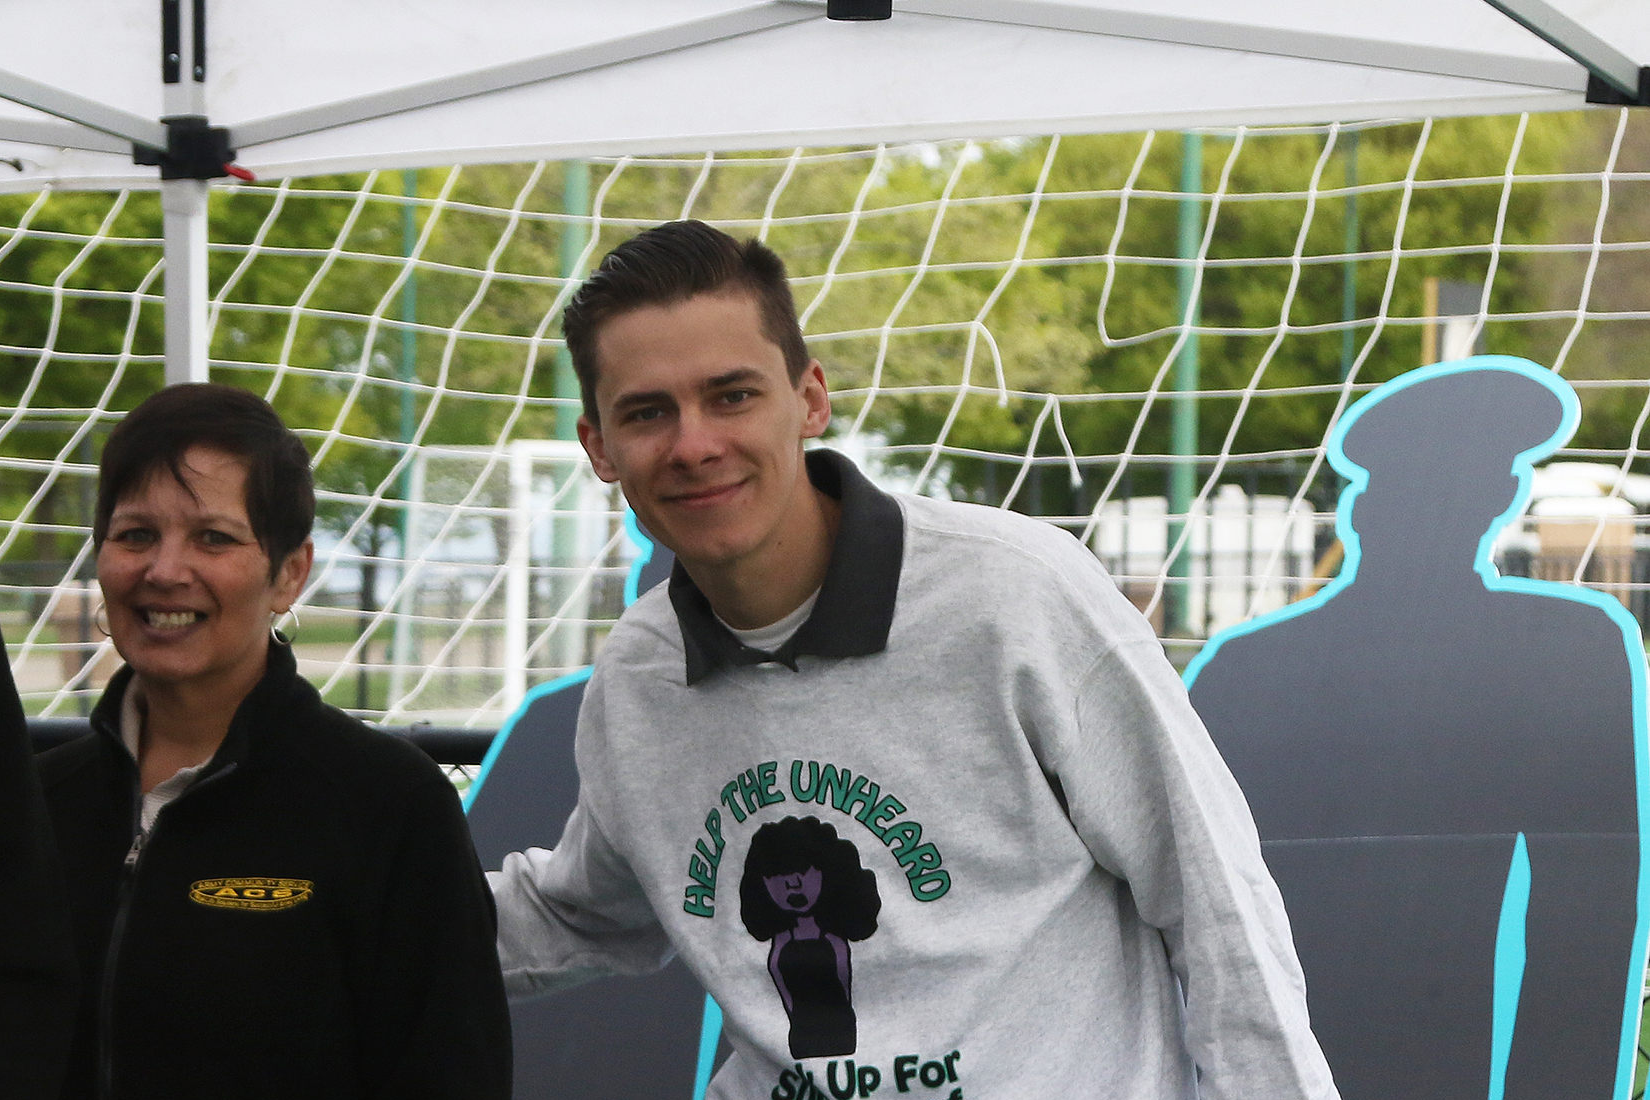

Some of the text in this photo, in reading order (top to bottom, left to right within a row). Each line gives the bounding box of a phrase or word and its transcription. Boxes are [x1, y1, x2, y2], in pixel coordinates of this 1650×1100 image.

[684, 760, 951, 918] HELP THE UNHEARD
[215, 887, 292, 898] ACS
[827, 1060, 881, 1100] Up
[894, 1050, 961, 1093] For
